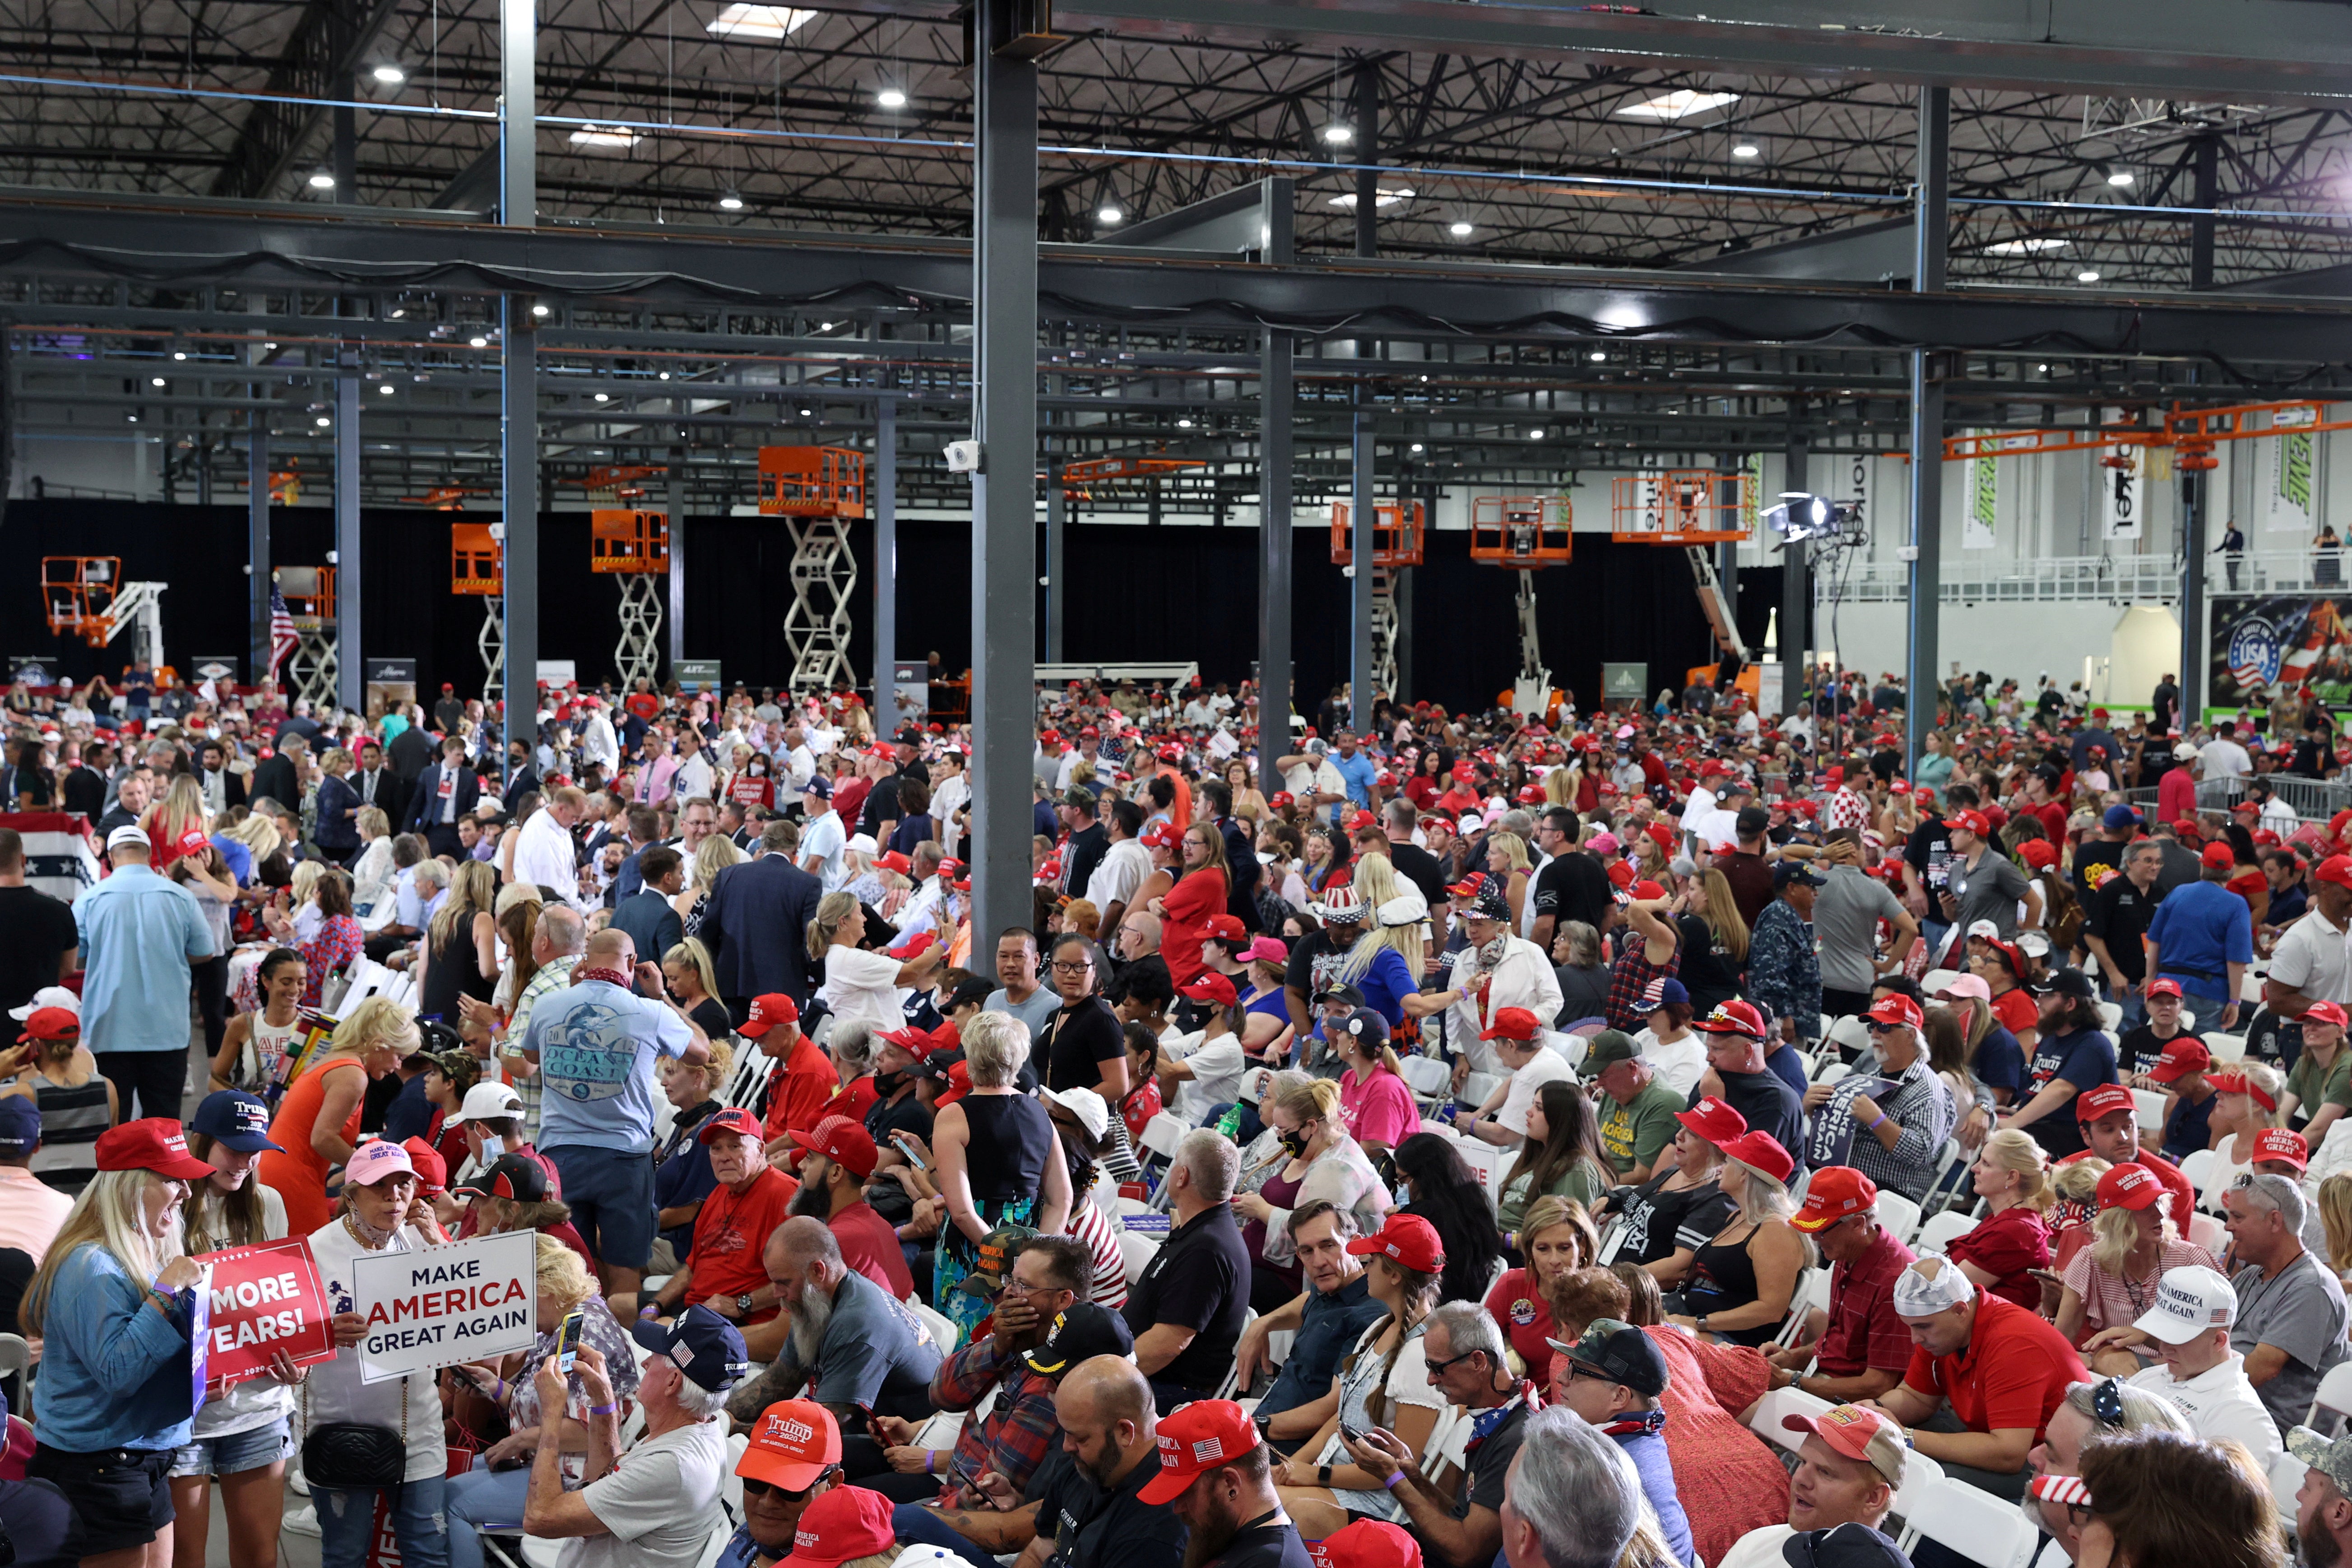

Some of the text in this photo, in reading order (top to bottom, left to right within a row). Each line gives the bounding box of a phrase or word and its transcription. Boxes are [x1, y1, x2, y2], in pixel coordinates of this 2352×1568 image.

[2240, 643, 2268, 665] USA
[548, 1030, 634, 1051] 20 12
[549, 1061, 620, 1078] COAST
[1814, 1110, 1829, 1161] AGAIN
[2272, 1129, 2295, 1139] KEEP
[2262, 1136, 2300, 1150] AMERICA
[2266, 1143, 2295, 1155] GREAT
[371, 1151, 389, 1160] GREAT
[412, 1260, 480, 1287] MAKE
[210, 1272, 301, 1314] MORE
[2167, 1286, 2203, 1308] AMERICA
[367, 1278, 526, 1327] AMERICA
[2167, 1304, 2195, 1319] AGAIN
[367, 1309, 527, 1355] GREAT AGAIN
[244, 1364, 265, 1375] 2020
[2173, 1396, 2198, 1411] TRUMP
[769, 1415, 813, 1443] Trump
[789, 1417, 813, 1432] President
[779, 1432, 798, 1442] 2020
[769, 1440, 789, 1450] AMERICA
[789, 1445, 805, 1454] GREAT
